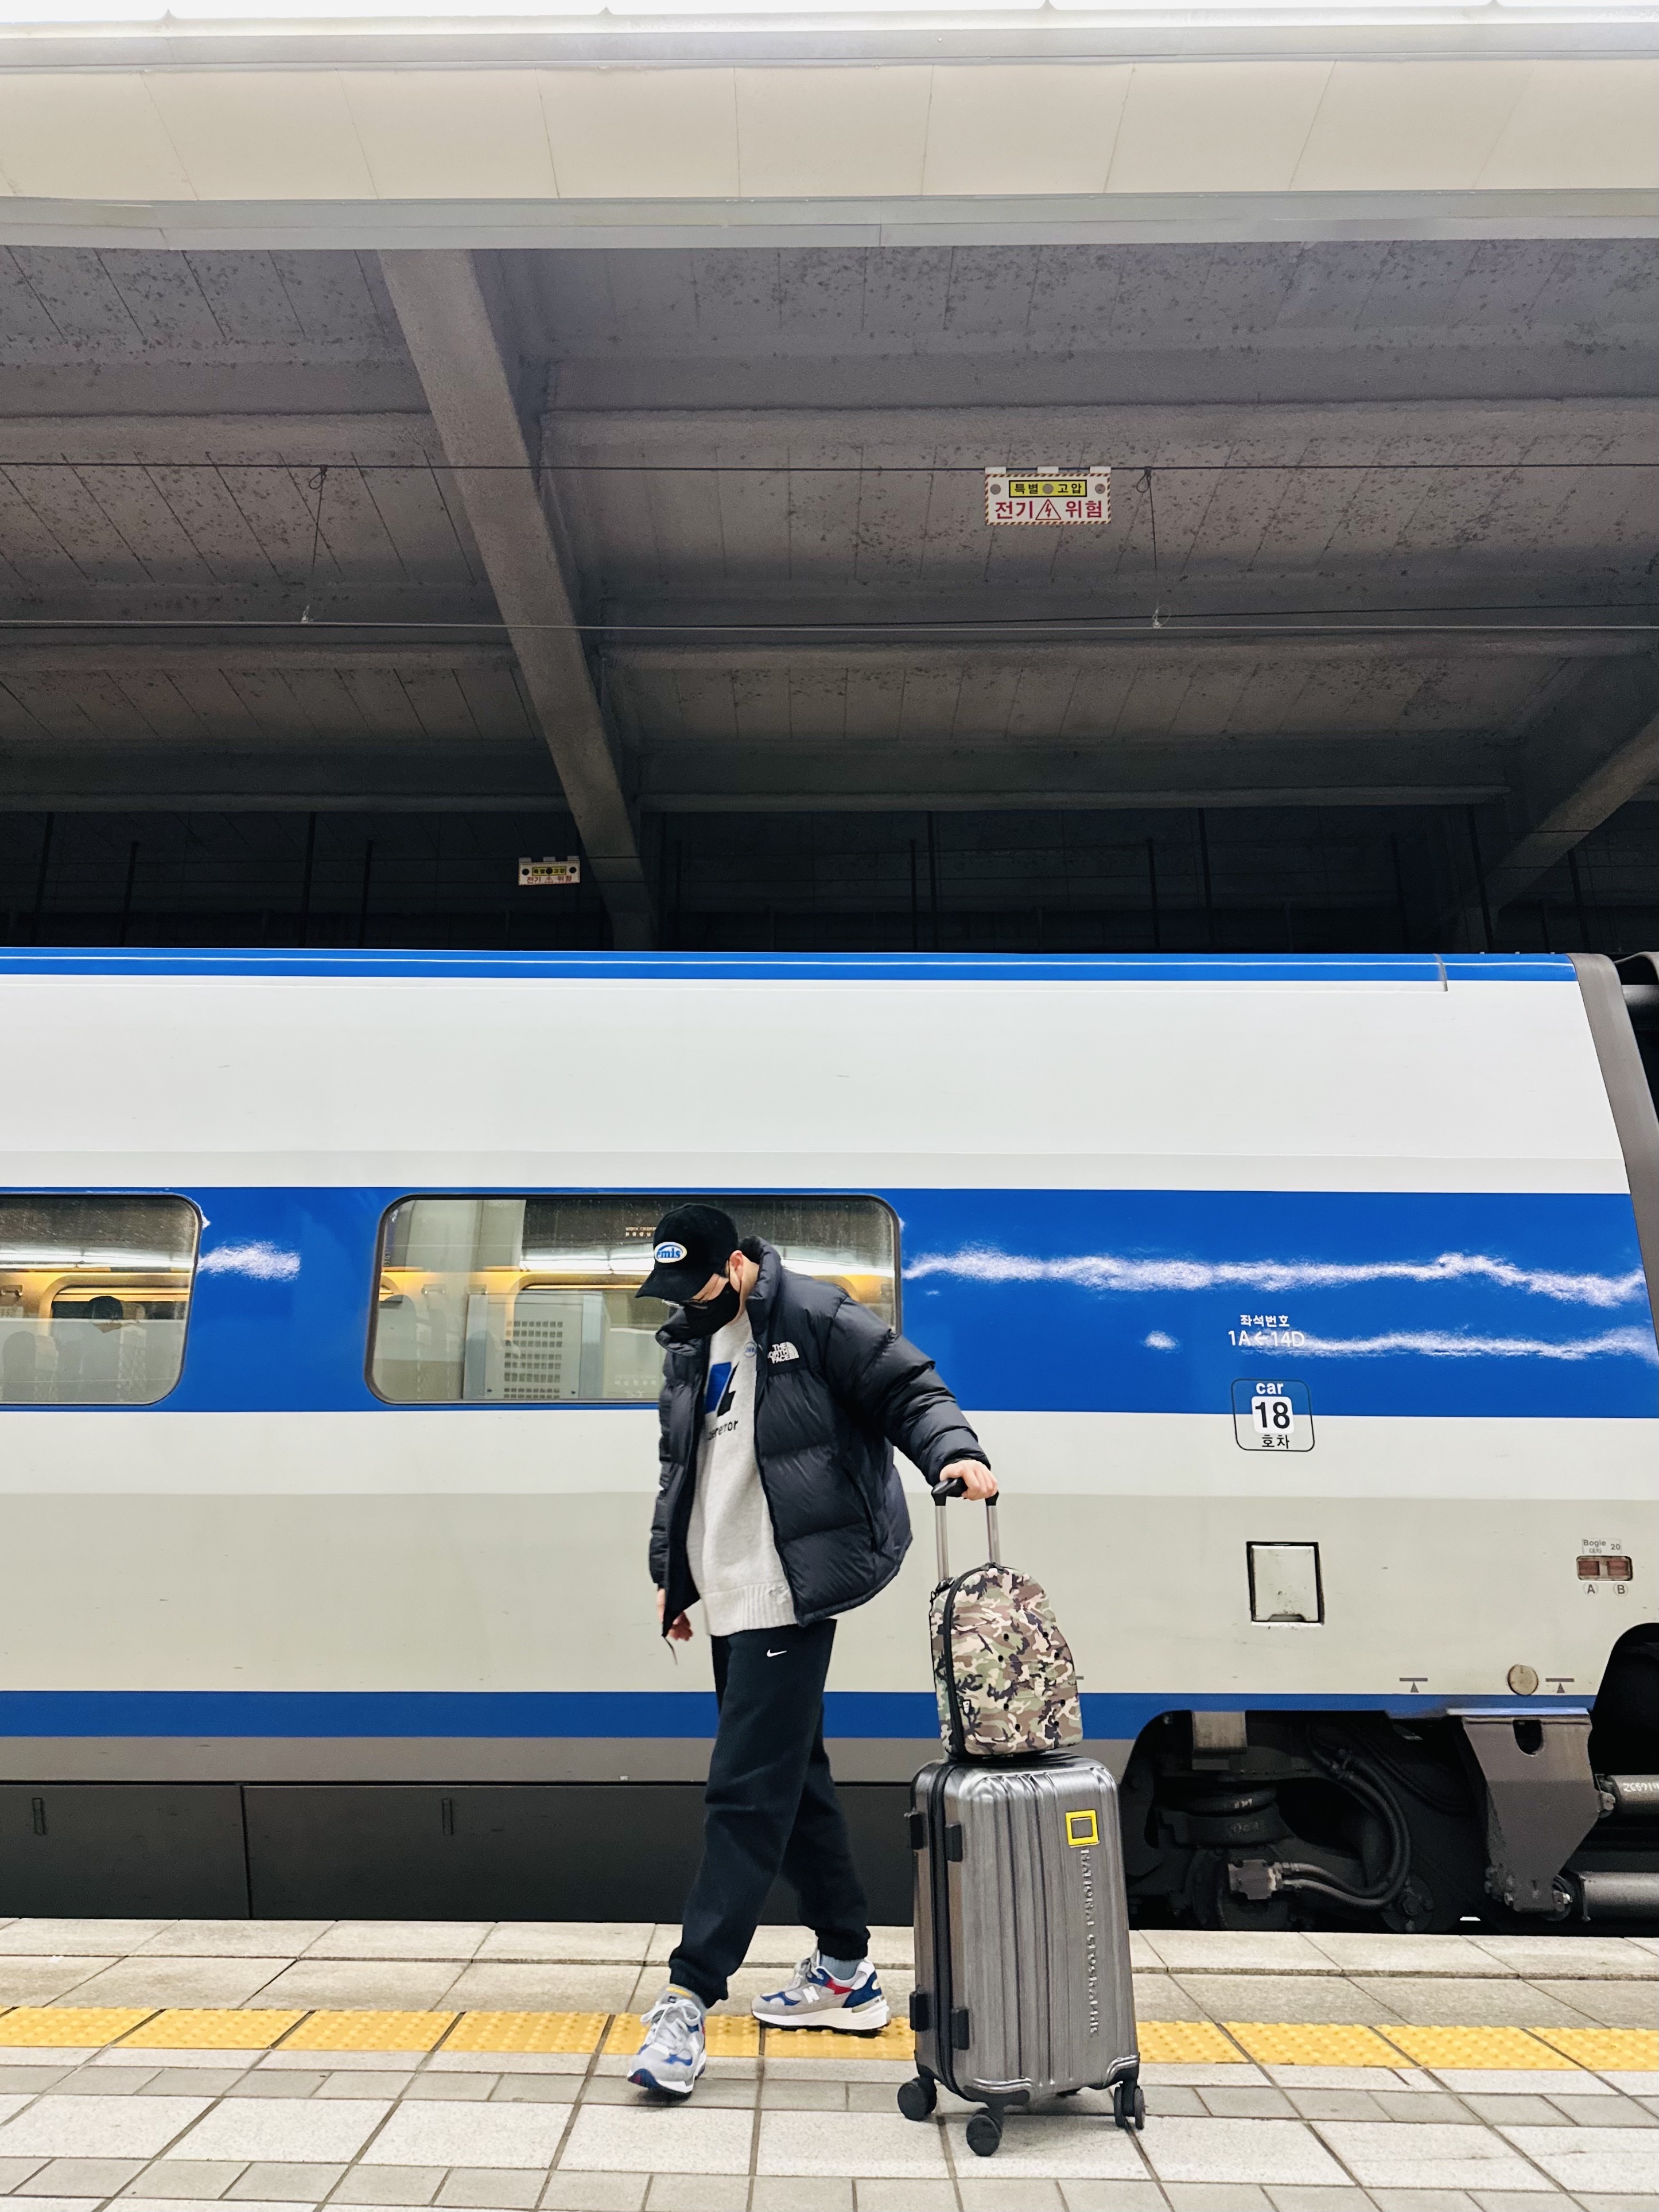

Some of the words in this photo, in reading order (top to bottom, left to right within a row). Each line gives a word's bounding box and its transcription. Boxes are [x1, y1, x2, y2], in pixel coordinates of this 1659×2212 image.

[1014, 483, 1039, 495] 특별
[1057, 483, 1082, 494] 고압
[994, 500, 1034, 519] 전기
[1065, 500, 1102, 518] 위험
[656, 1247, 681, 1259] emis
[1240, 1314, 1291, 1328] 좌석번호
[772, 1342, 787, 1351] THE
[772, 1355, 790, 1364] FACE
[1256, 1382, 1284, 1395] car
[1255, 1401, 1291, 1429] 18
[1261, 1434, 1290, 1449] 호차
[1583, 1540, 1607, 1548] Bogie
[1587, 1584, 1595, 1594] A
[1617, 1584, 1626, 1595] B
